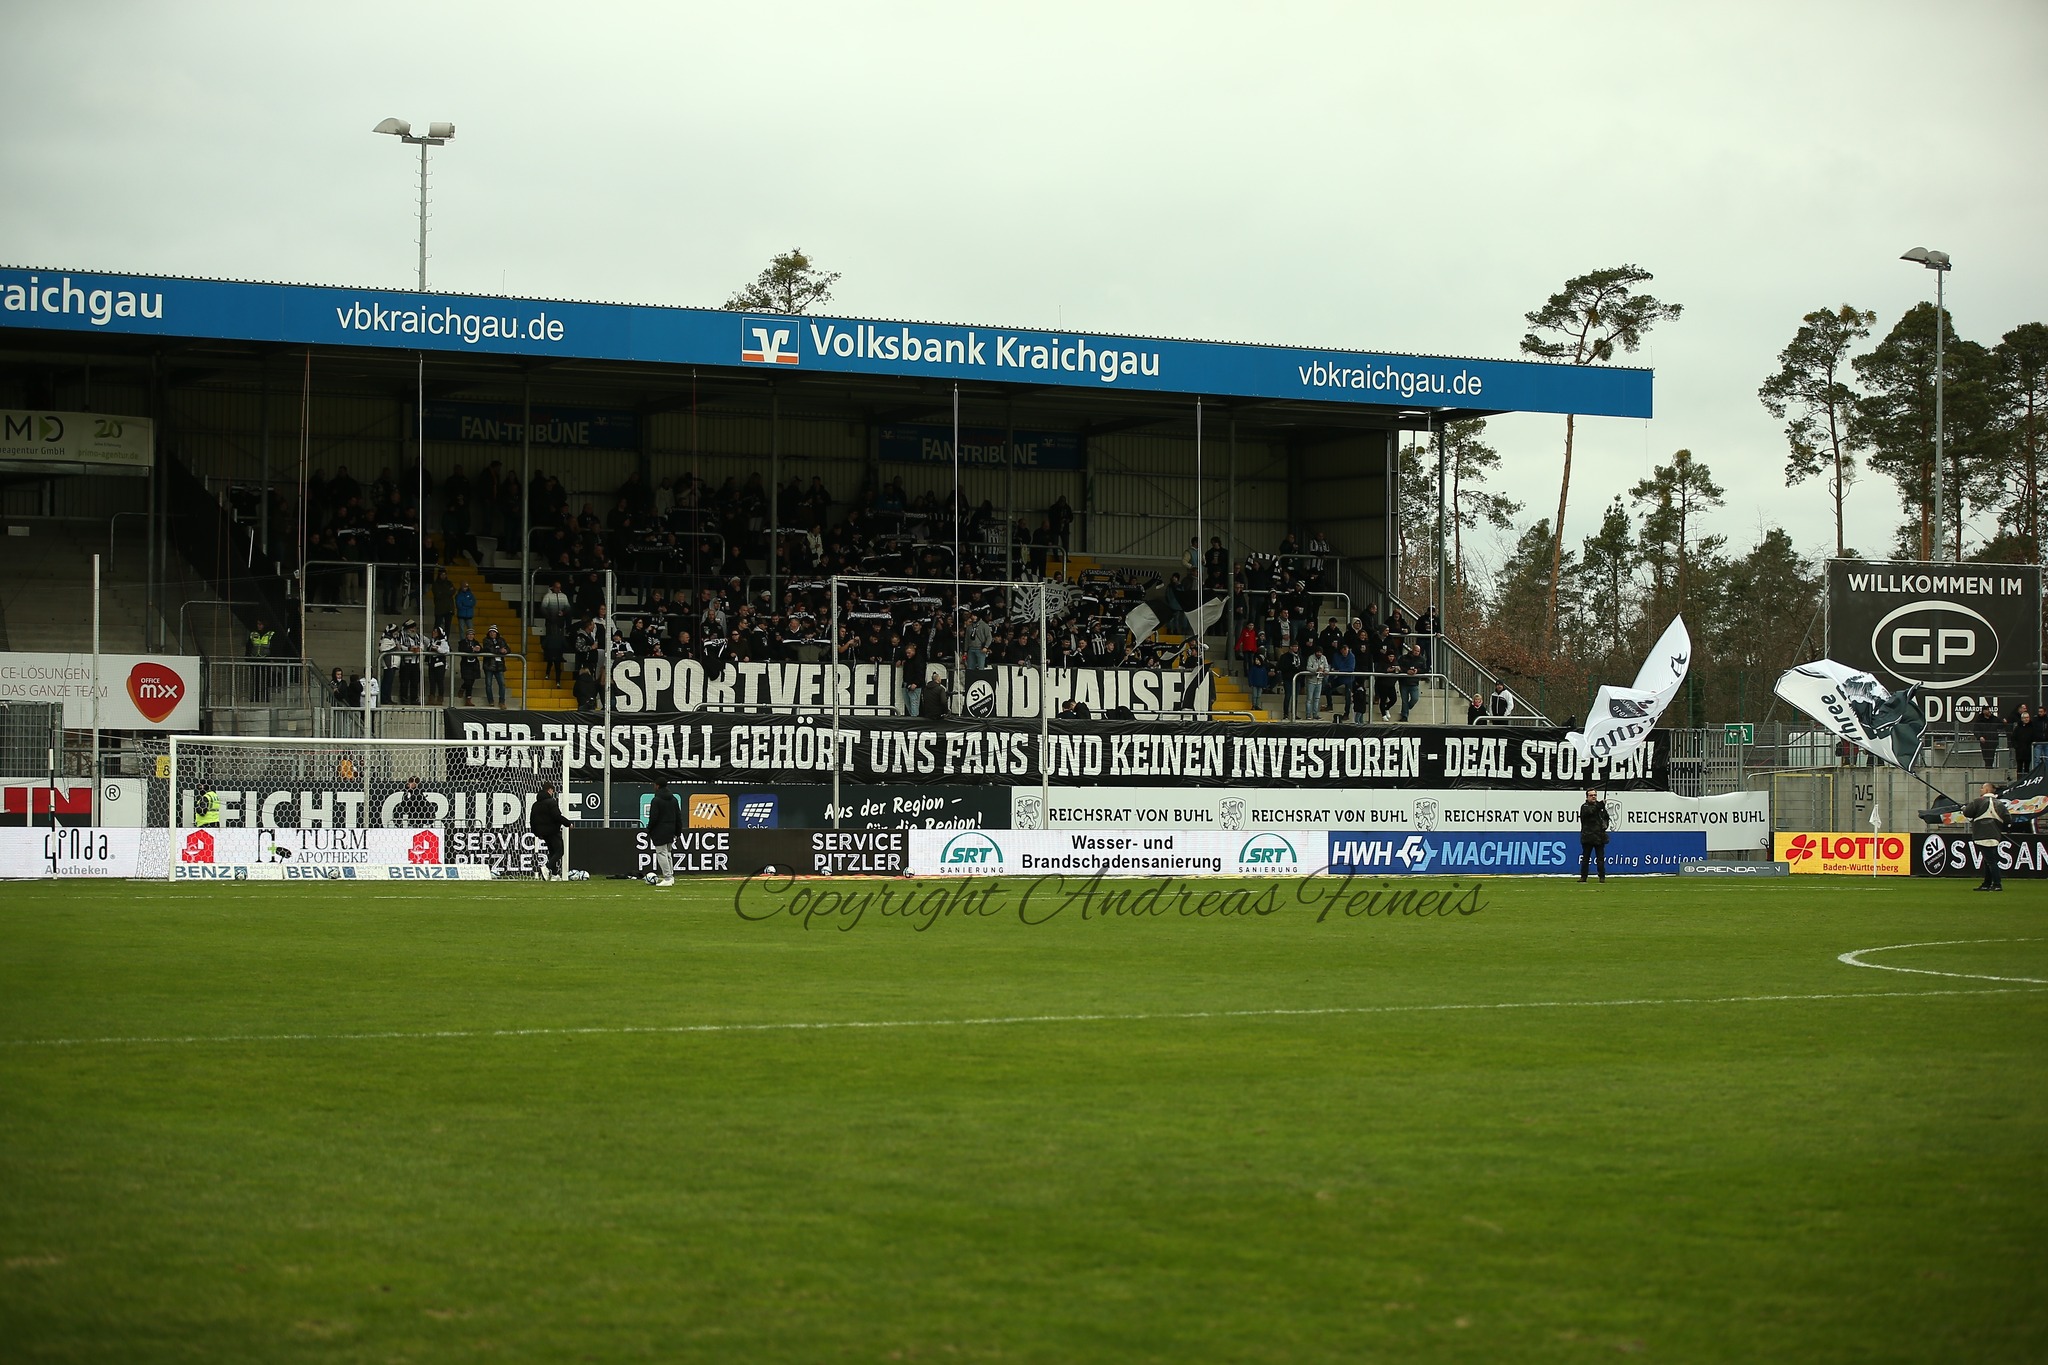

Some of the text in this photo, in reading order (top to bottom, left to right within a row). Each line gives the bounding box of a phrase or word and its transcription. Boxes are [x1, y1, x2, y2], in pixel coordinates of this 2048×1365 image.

[336, 302, 564, 343] vbkraichgau.de
[811, 323, 1160, 382] Volksbank Kraichgau
[1298, 360, 1481, 398] vbkraichgau.de
[41, 447, 65, 455] GmbH
[1847, 573, 2022, 596] WILLKOMMEN IM
[1892, 627, 1975, 665] GP
[2, 685, 107, 697] DAS GANZE TEAM
[971, 684, 986, 701] SV
[463, 722, 531, 768] DER
[541, 724, 719, 769] FUSSBALL
[728, 716, 860, 772] GEHÖRT
[869, 731, 937, 774] UNS
[943, 731, 1029, 775] FANS
[1039, 734, 1101, 777] UND
[1110, 735, 1225, 778] KEINEN
[1231, 737, 1420, 780] INVESTOREN
[1443, 738, 1513, 779] DEAL
[824, 803, 854, 820] Aus
[860, 798, 886, 817] der
[893, 795, 944, 818] Region
[1049, 809, 1213, 822] REICHSRAT VON BUHL
[1252, 810, 1407, 823] REICHSRAT VON BUHL
[1444, 810, 1519, 823] REICHSRAT
[1523, 811, 1552, 823] VON
[1628, 810, 1765, 824] REICHSRAT VON BUHL
[297, 829, 369, 850] TURM
[811, 833, 903, 851] SERVICE
[1071, 836, 1173, 850] Wasser- und
[1926, 838, 1939, 856] SV
[952, 848, 994, 863] SRT
[1249, 849, 1287, 864] SRT
[1332, 841, 1566, 866] HWH MACHINES
[1821, 837, 1904, 860] LOTTO
[297, 852, 368, 863] APOTHEKE
[638, 853, 729, 871] PIZLER
[814, 853, 901, 871] PITZLER
[1022, 855, 1221, 872] Brandschadensanierung
[1645, 854, 1703, 864] Solutions
[176, 866, 230, 879] BENZ
[389, 867, 444, 879] BENZ
